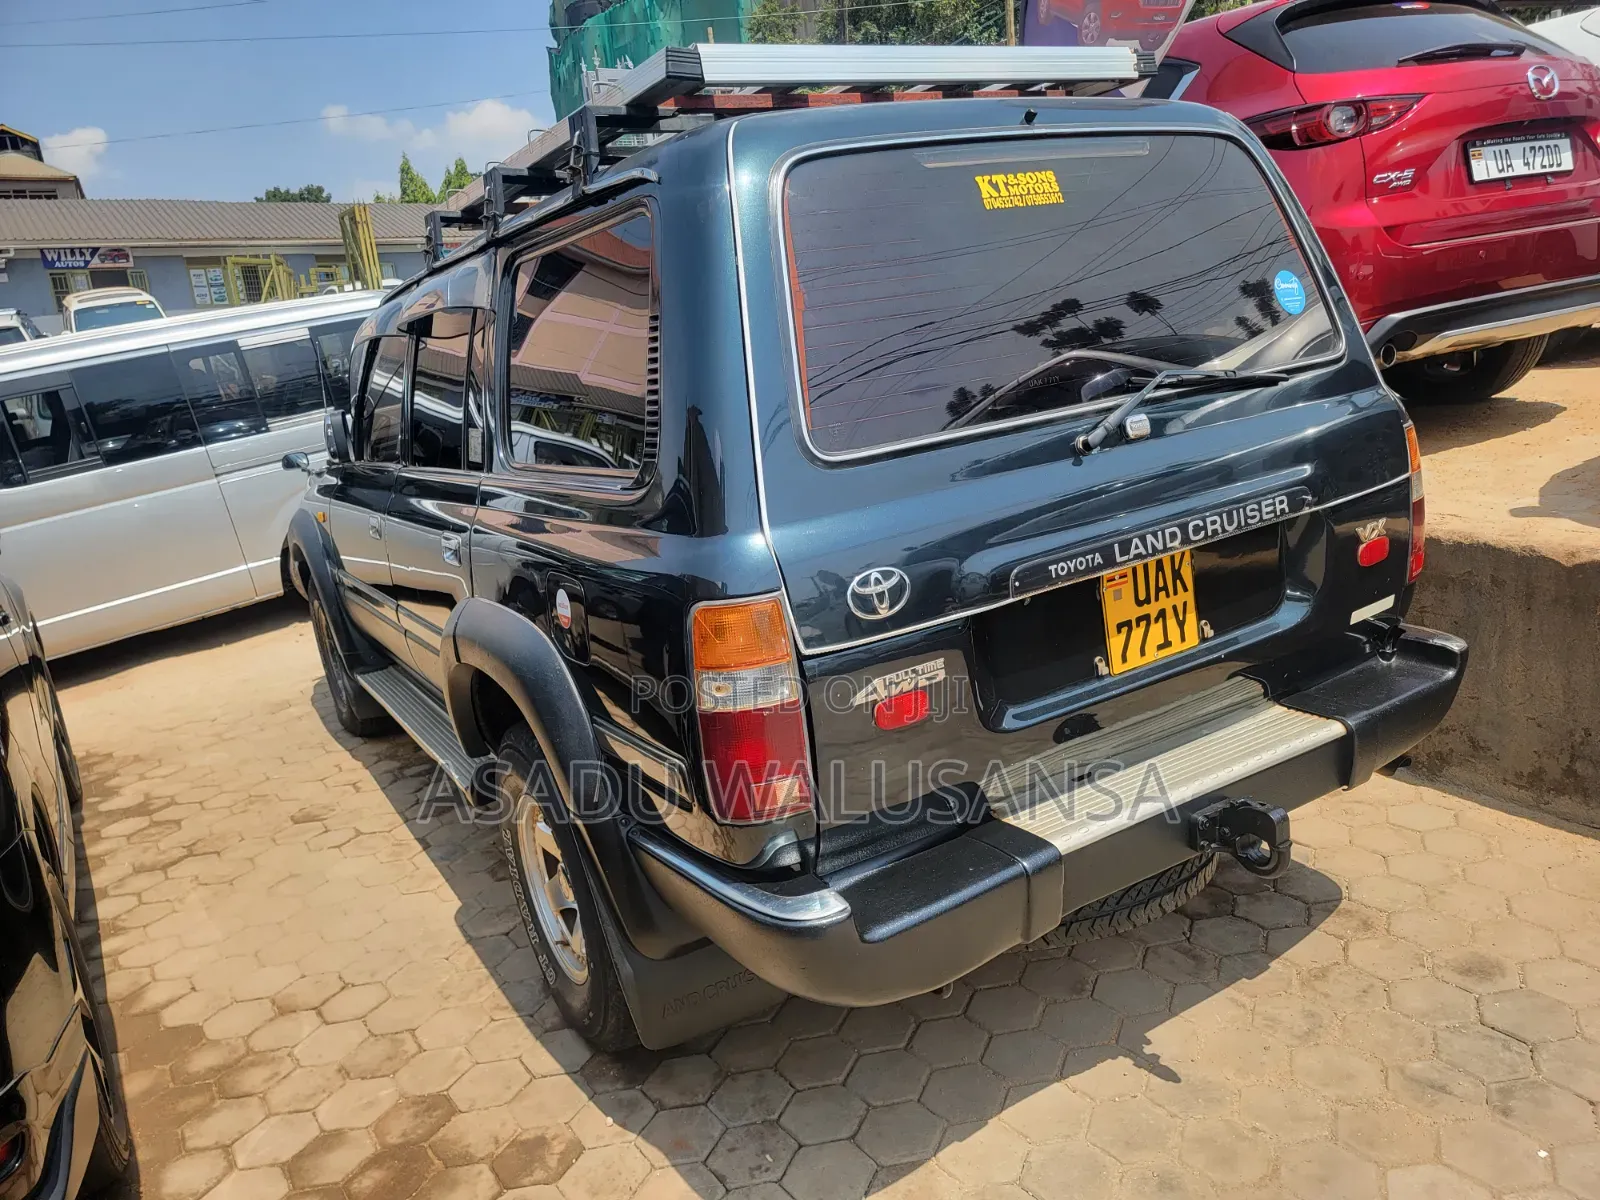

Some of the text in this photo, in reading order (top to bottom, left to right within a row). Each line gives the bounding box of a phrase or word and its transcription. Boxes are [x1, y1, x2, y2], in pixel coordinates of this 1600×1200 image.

[1493, 148, 1515, 174] UA
[975, 173, 1010, 199] KT
[1008, 181, 1060, 197] MOTORS
[1372, 168, 1416, 184] CX-5
[42, 248, 93, 262] WILLY
[54, 260, 85, 268] AUTOS
[1048, 495, 1290, 579] TOYOTA LAND CRUISER
[1355, 517, 1387, 543] VX
[1131, 551, 1189, 608] UAK
[1115, 600, 1188, 665] 771Y
